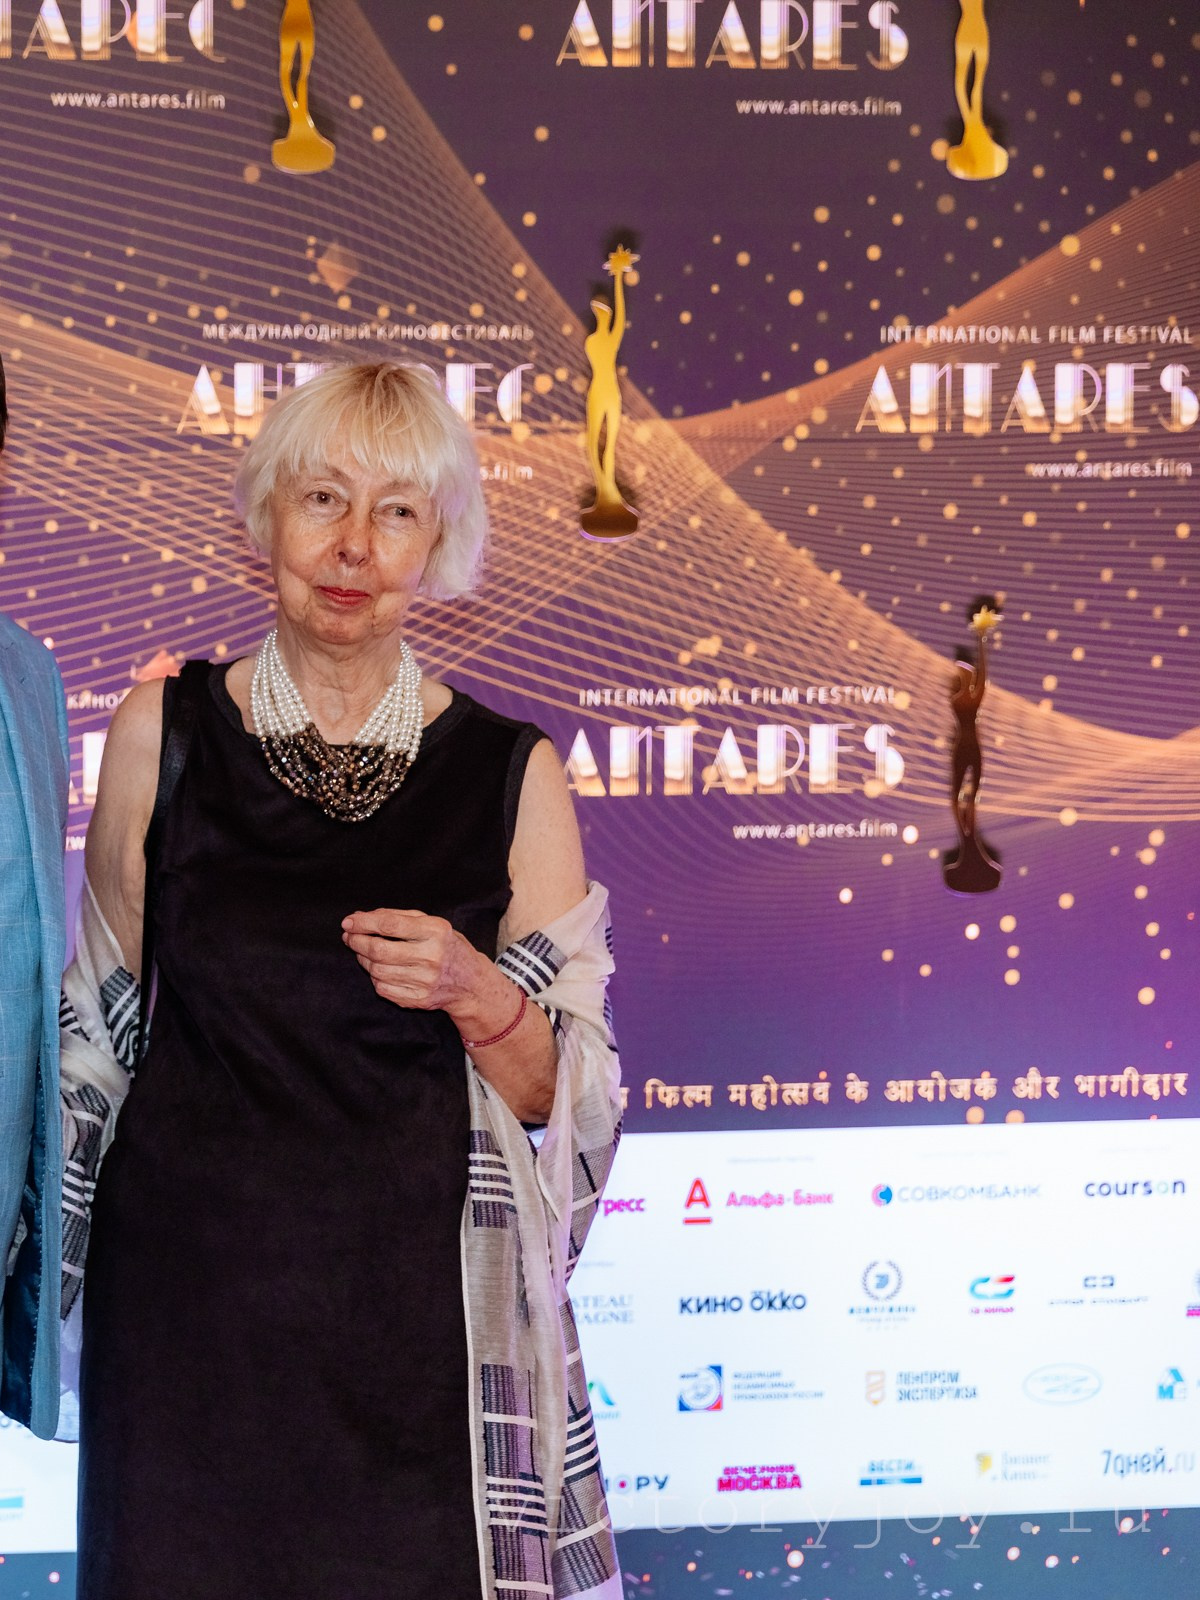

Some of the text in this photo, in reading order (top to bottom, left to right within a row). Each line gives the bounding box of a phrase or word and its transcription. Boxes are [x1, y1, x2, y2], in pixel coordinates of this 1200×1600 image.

[555, 0, 910, 71] ANTARES
[50, 90, 226, 110] www.antares.film
[736, 97, 902, 116] www.antares.film
[202, 322, 535, 342] МЕЖДУНАРОДНЫЙ КИНОФЕСТИВАЛЬ
[880, 324, 1193, 345] INTERNATIONAL FILM FESTIVAL
[855, 362, 1200, 434] ANTARES
[1031, 458, 1193, 478] www.antares.film
[579, 685, 898, 707] INTERNATIONAL FILM FESTIVAL
[563, 723, 906, 797] ANTARES
[732, 818, 898, 840] www.antares.film
[845, 1072, 870, 1104] के
[1012, 1066, 1061, 1101] और
[897, 1183, 1042, 1203] СОВКОМБАНК
[1084, 1180, 1186, 1198] courson
[602, 1198, 646, 1217] ресс
[679, 1296, 743, 1315] КИНО
